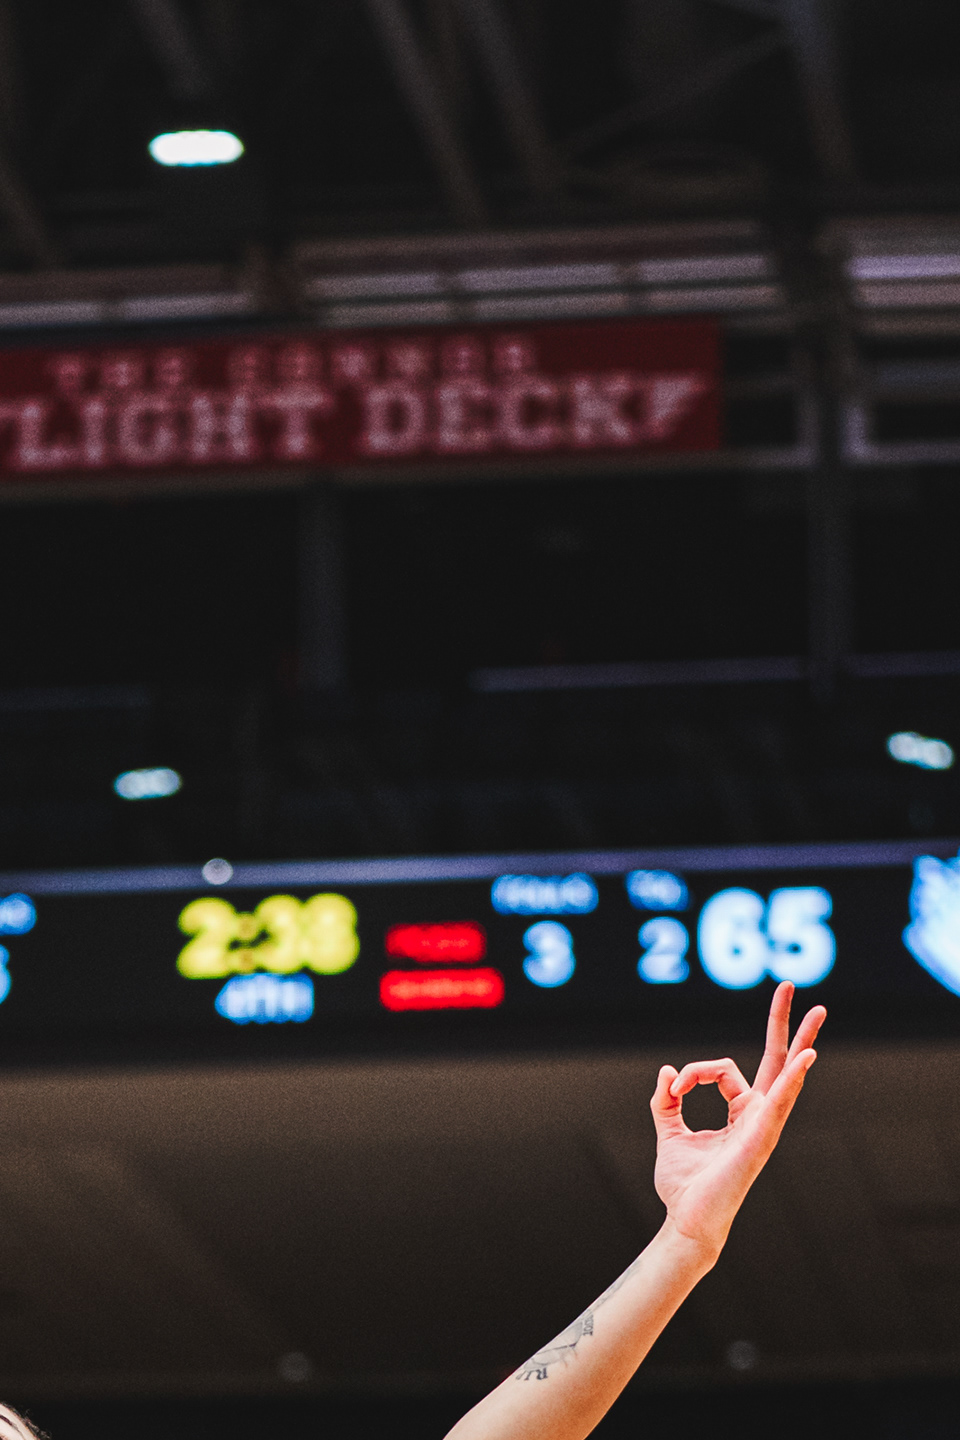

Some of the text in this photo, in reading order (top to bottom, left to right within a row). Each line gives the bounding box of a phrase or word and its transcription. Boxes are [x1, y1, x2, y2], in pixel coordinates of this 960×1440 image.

[360, 370, 644, 458] DECK
[177, 893, 360, 979] 2:38
[522, 920, 576, 988] 3
[637, 916, 690, 984] 2
[698, 886, 836, 988] 65
